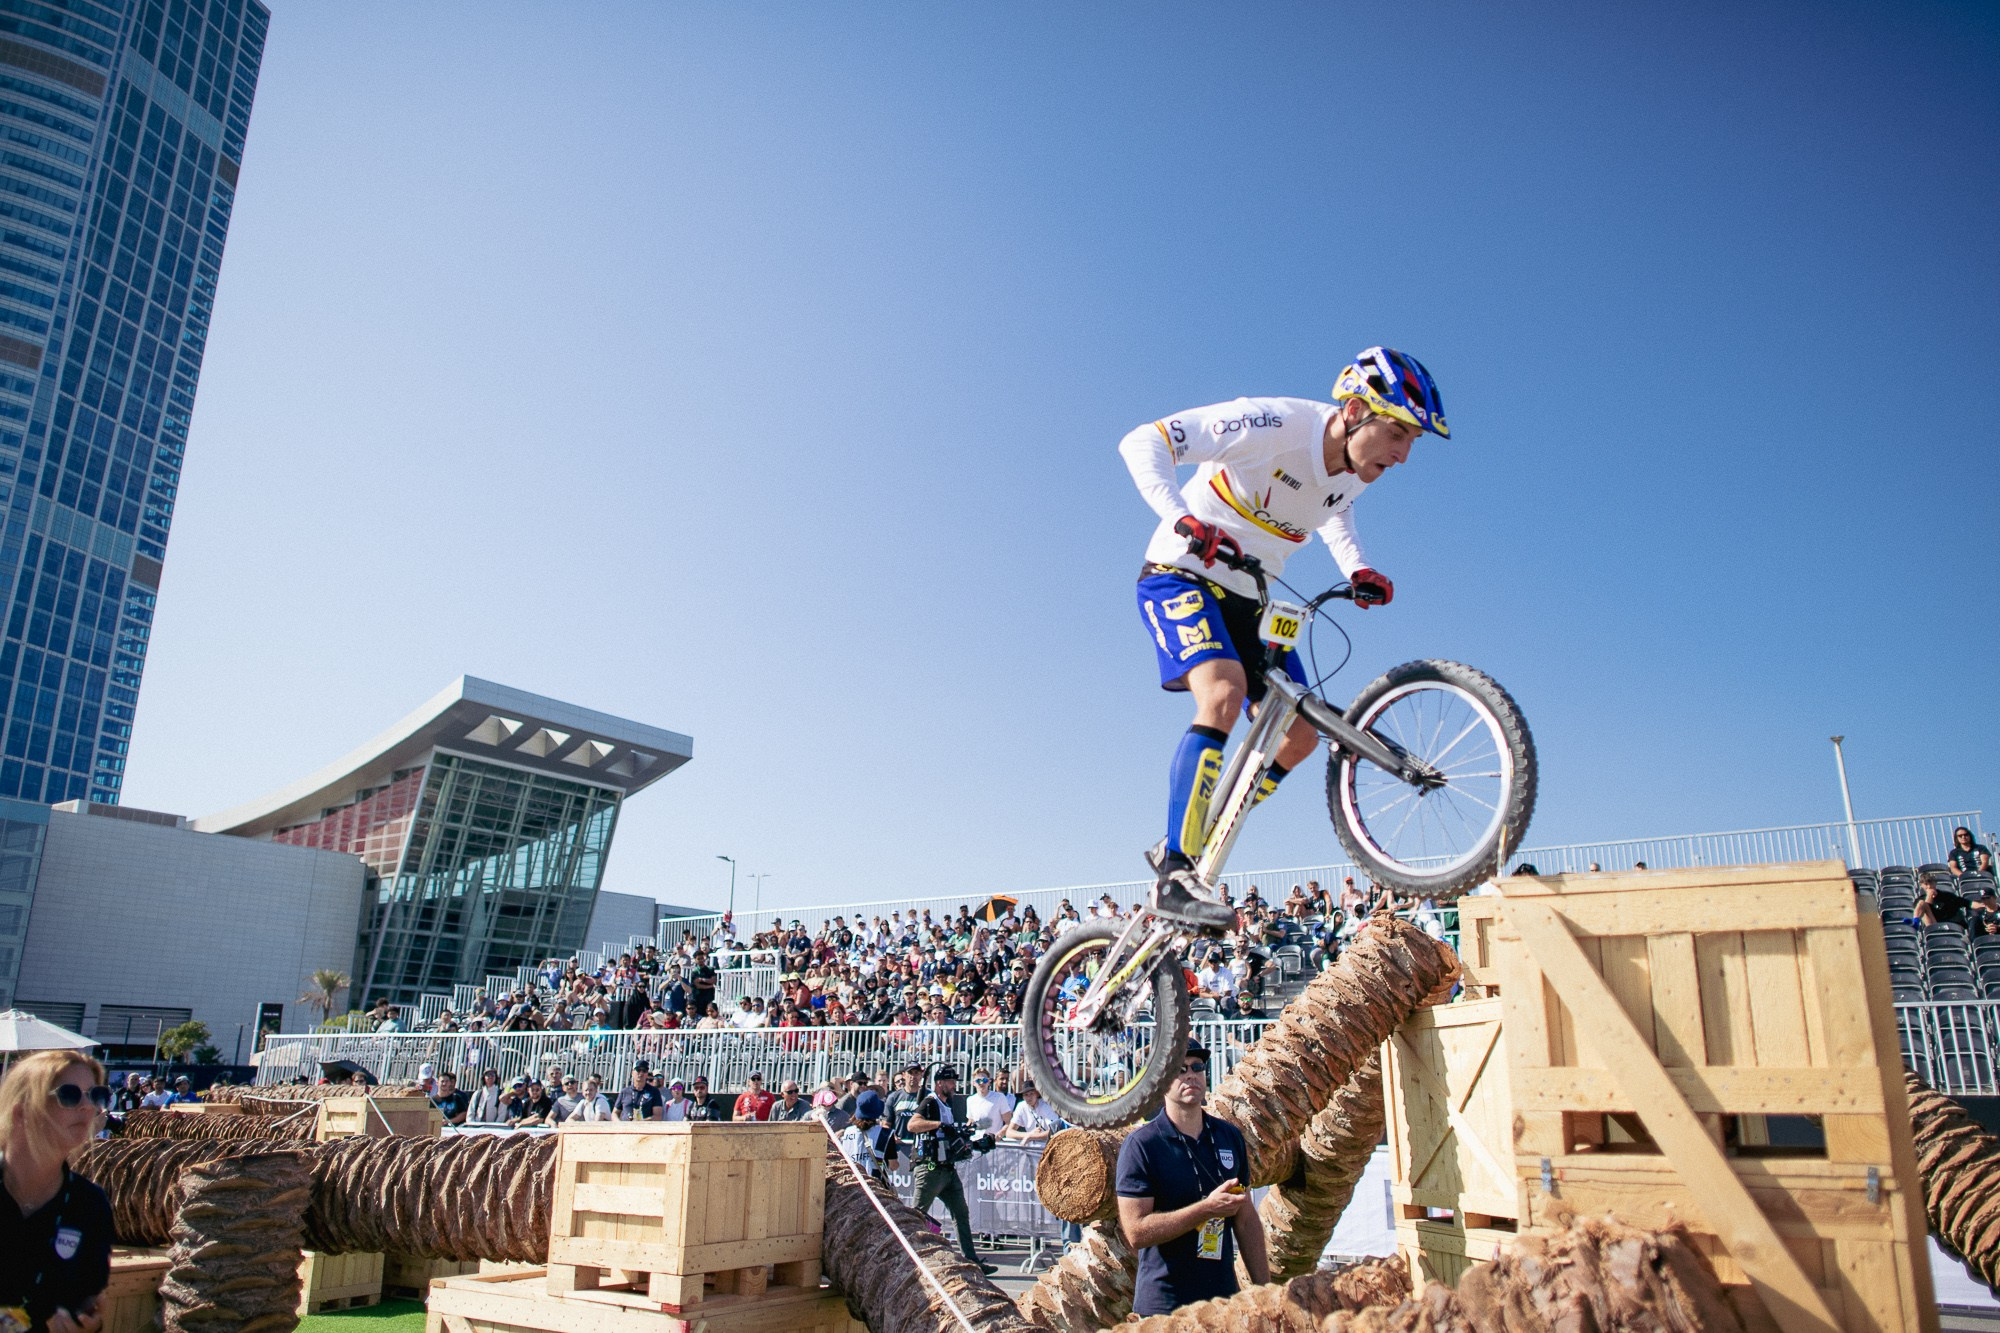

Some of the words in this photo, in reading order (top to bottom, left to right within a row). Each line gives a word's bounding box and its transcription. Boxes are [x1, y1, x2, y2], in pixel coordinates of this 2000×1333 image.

[1213, 412, 1284, 436] Cofidis
[1275, 617, 1299, 639] 102
[1179, 641, 1223, 661] COMAS
[851, 1152, 871, 1164] STAFF
[976, 1172, 1010, 1191] bike
